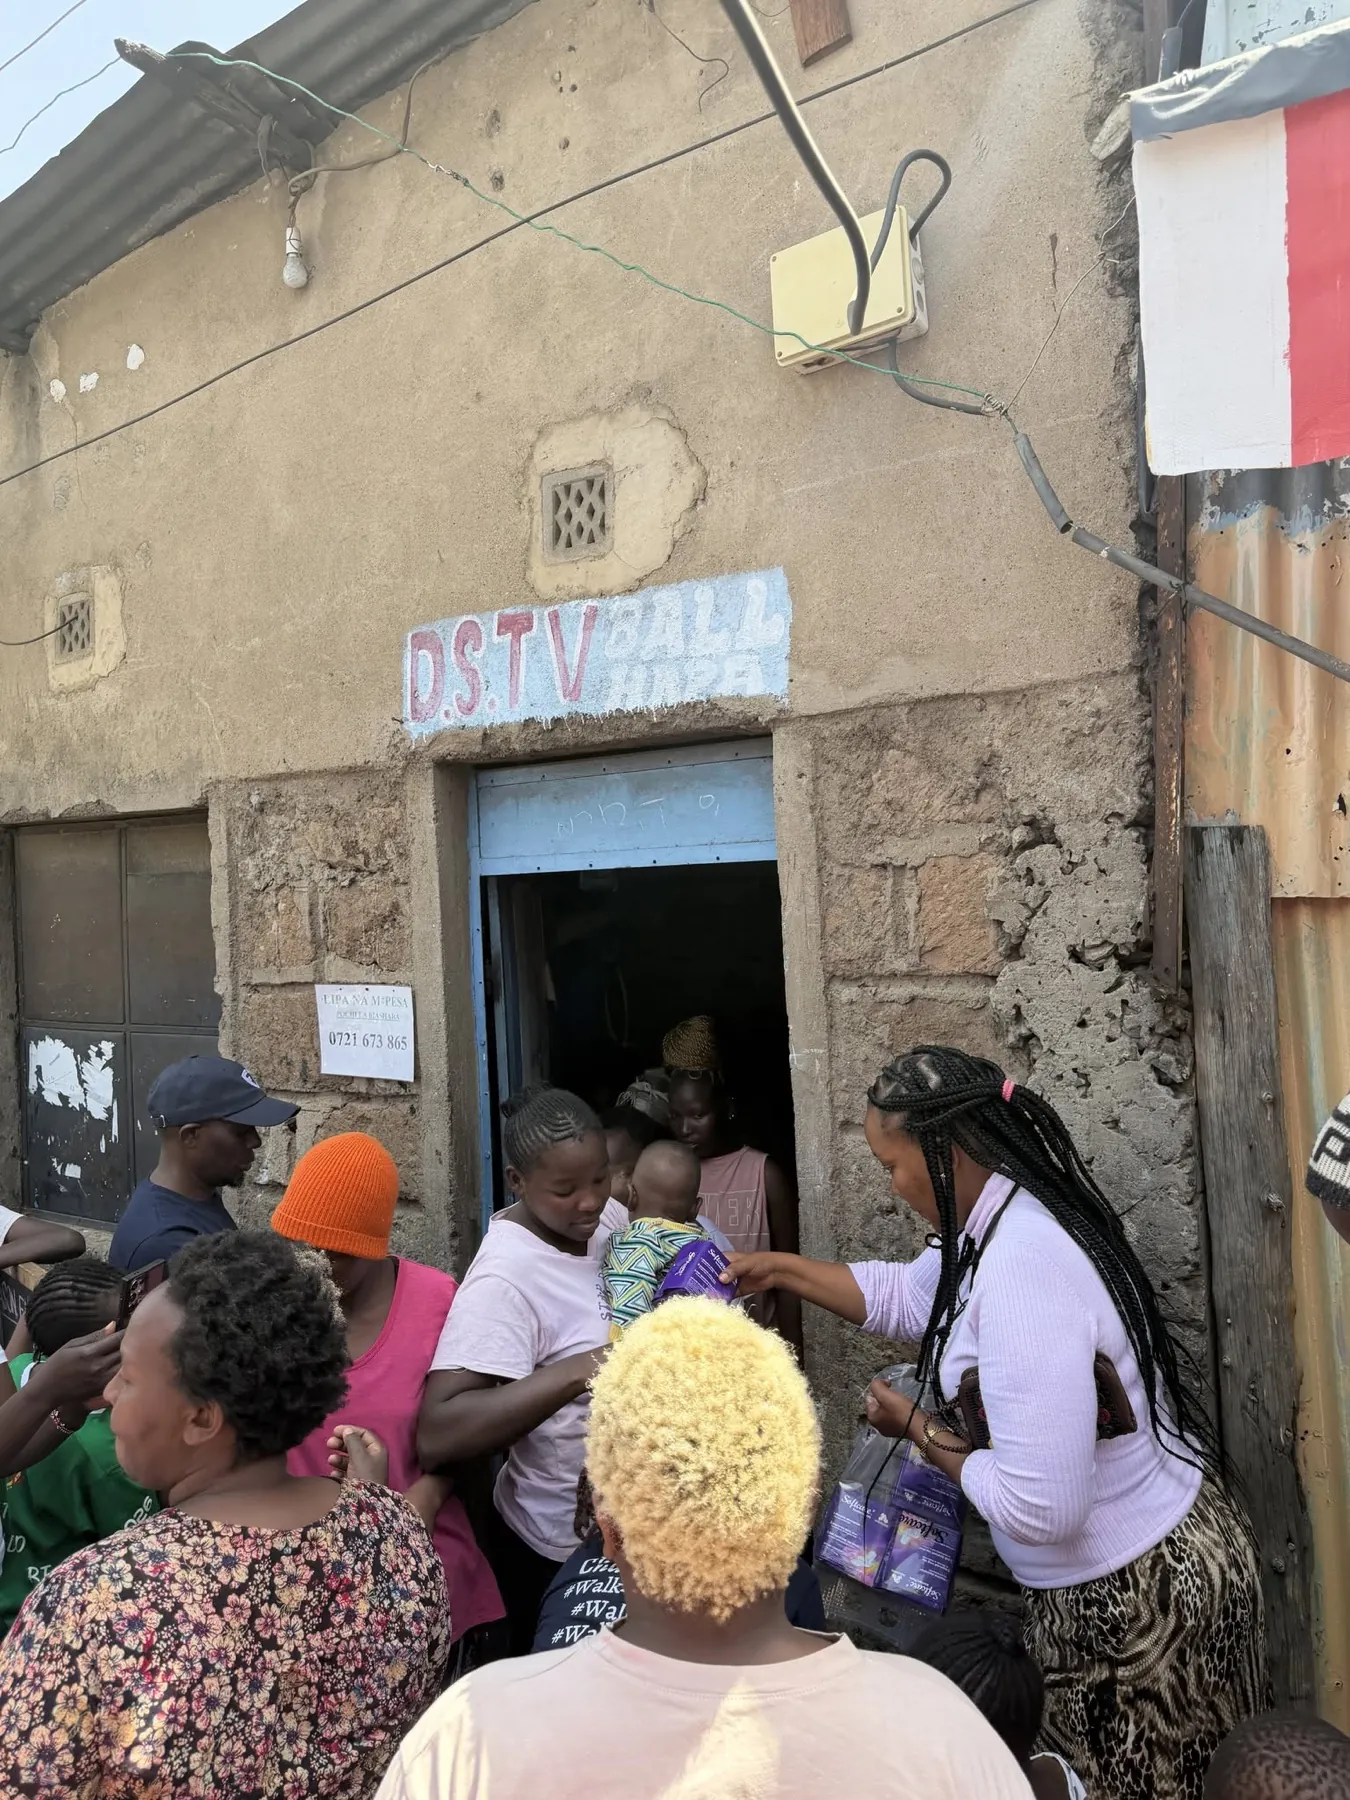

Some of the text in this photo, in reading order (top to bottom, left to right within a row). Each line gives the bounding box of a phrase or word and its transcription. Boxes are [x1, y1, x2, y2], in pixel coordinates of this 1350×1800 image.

[604, 578, 785, 661] BALL
[408, 604, 600, 722] D.S.TV
[323, 994, 349, 1005] LIPA
[352, 995, 368, 1006] NA
[328, 1031, 408, 1051] 0721 673 865
[841, 1494, 872, 1514] Softcae
[900, 1514, 948, 1544] Softcare
[909, 1581, 941, 1600] Softcare
